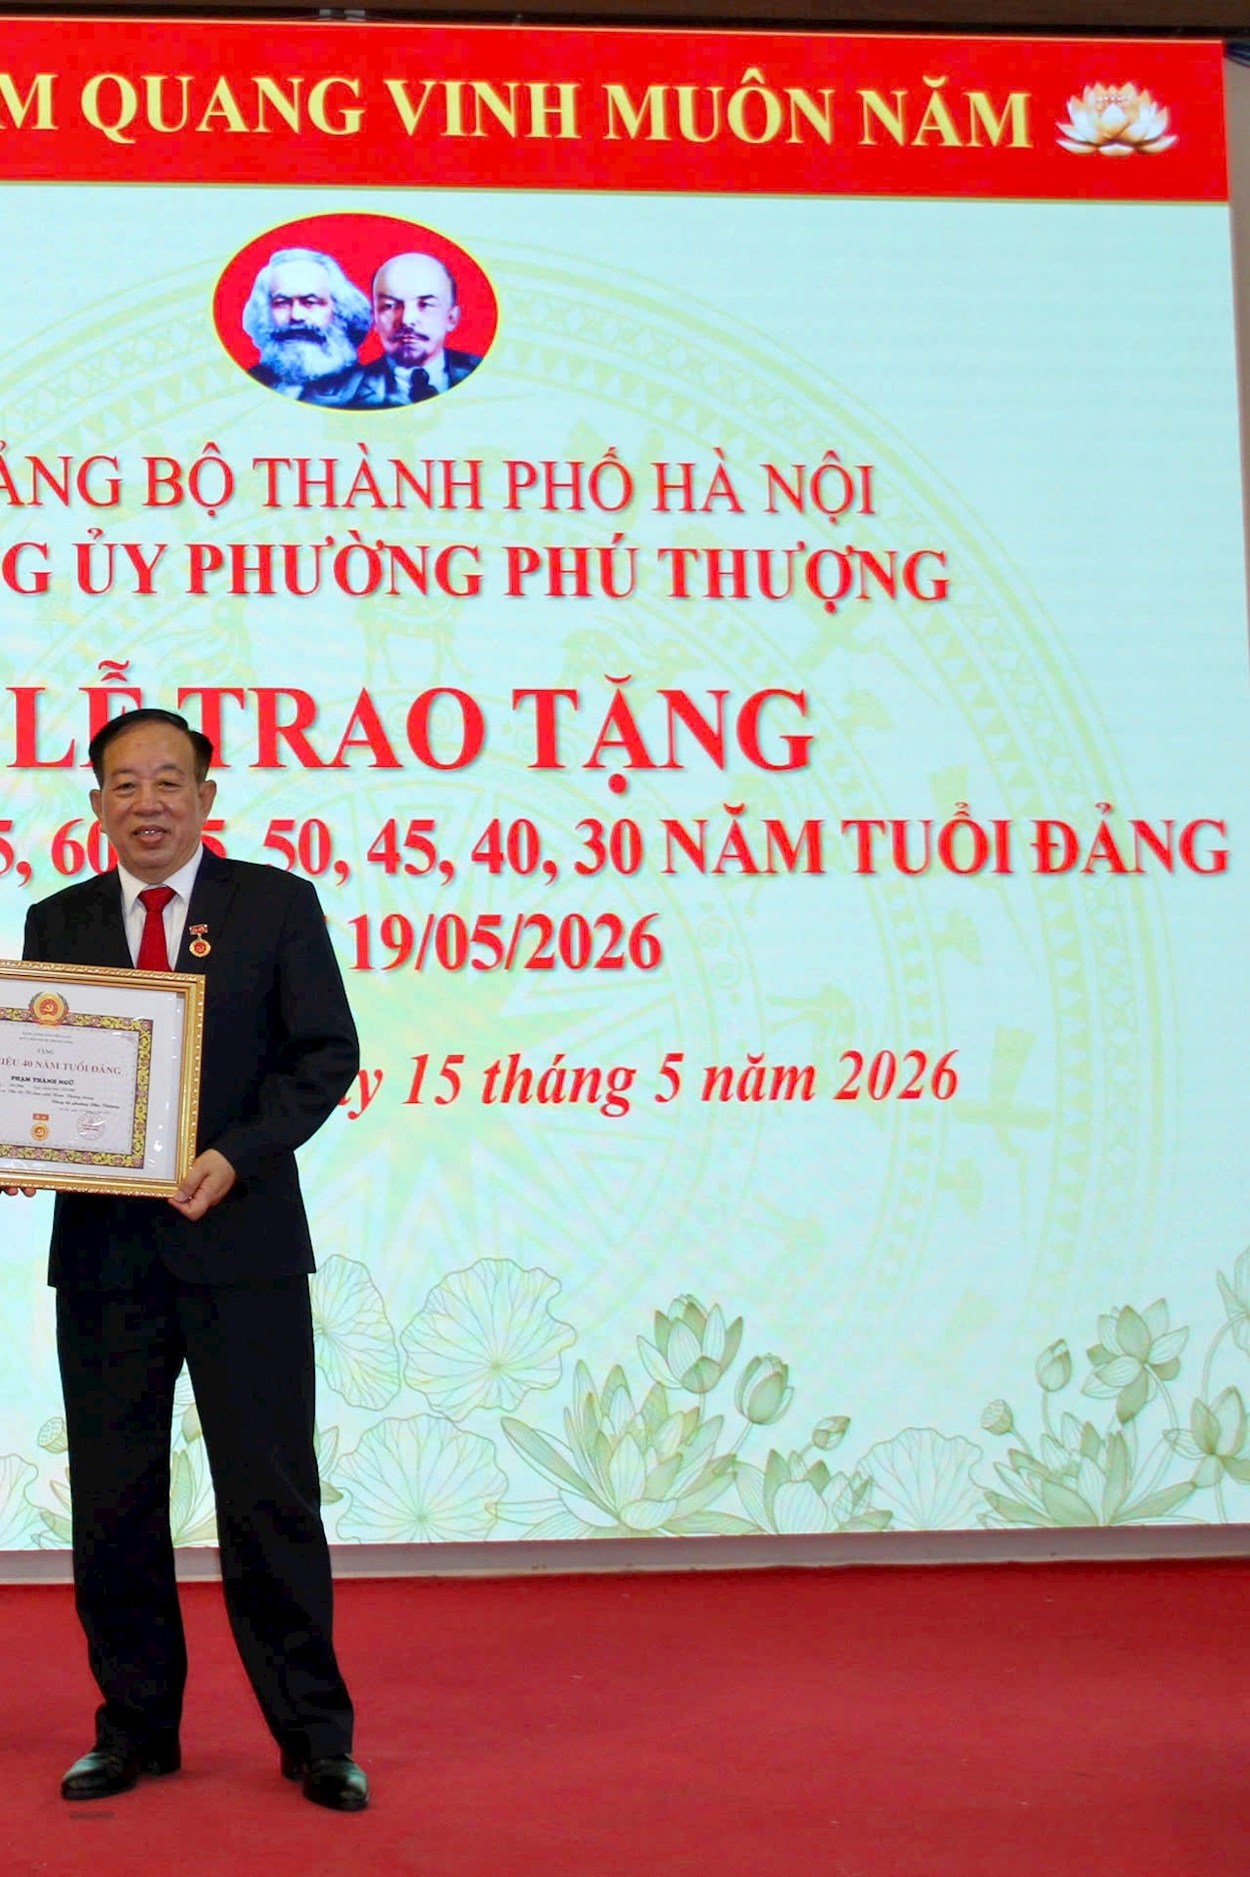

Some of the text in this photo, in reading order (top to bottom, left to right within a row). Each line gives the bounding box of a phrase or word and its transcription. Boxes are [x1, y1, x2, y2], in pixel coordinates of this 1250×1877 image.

[81, 73, 366, 144] QUANG
[384, 79, 580, 139] VINH
[604, 67, 834, 144] MUÔN
[857, 76, 1032, 149] NĂM
[143, 442, 235, 519] BỘ
[253, 442, 484, 511] THÀNH
[505, 446, 634, 512] PHỐ
[653, 447, 745, 513] HÀ
[762, 449, 874, 523] NỘI
[74, 528, 167, 595] ỦY
[187, 529, 482, 597] PHƯỜNG
[505, 532, 638, 600] PHÚ
[657, 541, 949, 614] THƯỢNG
[177, 685, 485, 771] TRAO
[512, 674, 814, 795] TẶNG
[263, 818, 350, 886] 50,
[367, 818, 455, 886] 45,
[471, 818, 558, 885] 40,
[574, 818, 643, 876] 30
[661, 803, 825, 875] NĂM
[841, 802, 1013, 876] TUỔI
[1031, 802, 1229, 876] ĐẢNG
[348, 913, 662, 971] 19/05/2026
[22, 1060, 33, 1068] 40
[34, 1060, 59, 1070] NĂM
[401, 1053, 466, 1106] 15
[482, 1053, 637, 1118] tháng
[655, 1053, 684, 1104] 5
[701, 1053, 816, 1102] năm
[834, 1049, 959, 1102] 2026
